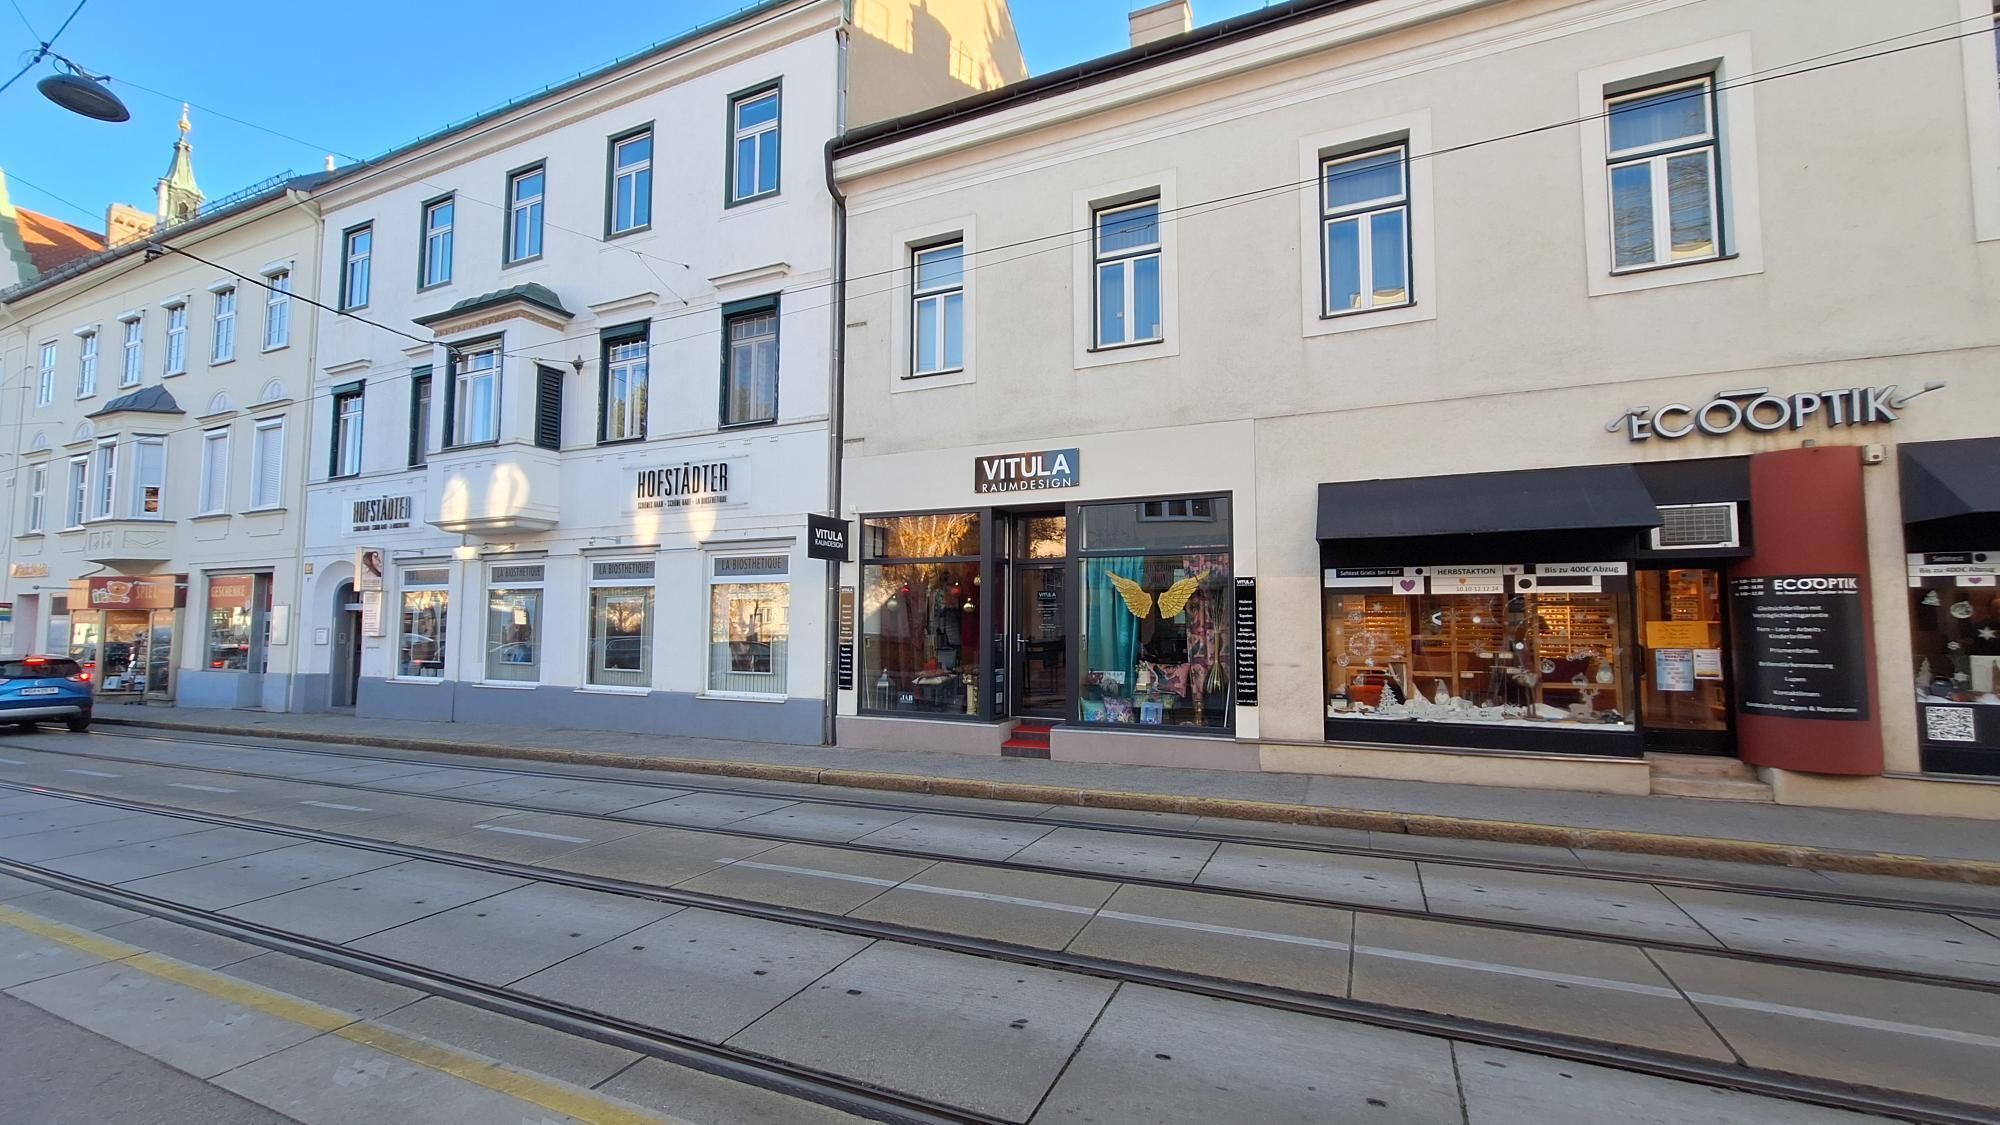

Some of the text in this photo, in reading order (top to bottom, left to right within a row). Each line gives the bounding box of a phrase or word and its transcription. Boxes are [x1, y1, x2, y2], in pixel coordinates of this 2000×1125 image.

[1630, 385, 1899, 442] ECOOPTIK
[983, 454, 1070, 480] VITULA
[638, 462, 728, 498] HOFSTÄDTER
[982, 477, 1072, 493] RAUMDESIGN
[353, 495, 411, 523] HOFSTÄDTER
[815, 528, 843, 542] VITULA
[600, 561, 650, 575] LA BIOSTHETIQUE
[722, 557, 782, 570] LA BIOSTHETIQUE
[1774, 578, 1857, 590] ECOOPTIK
